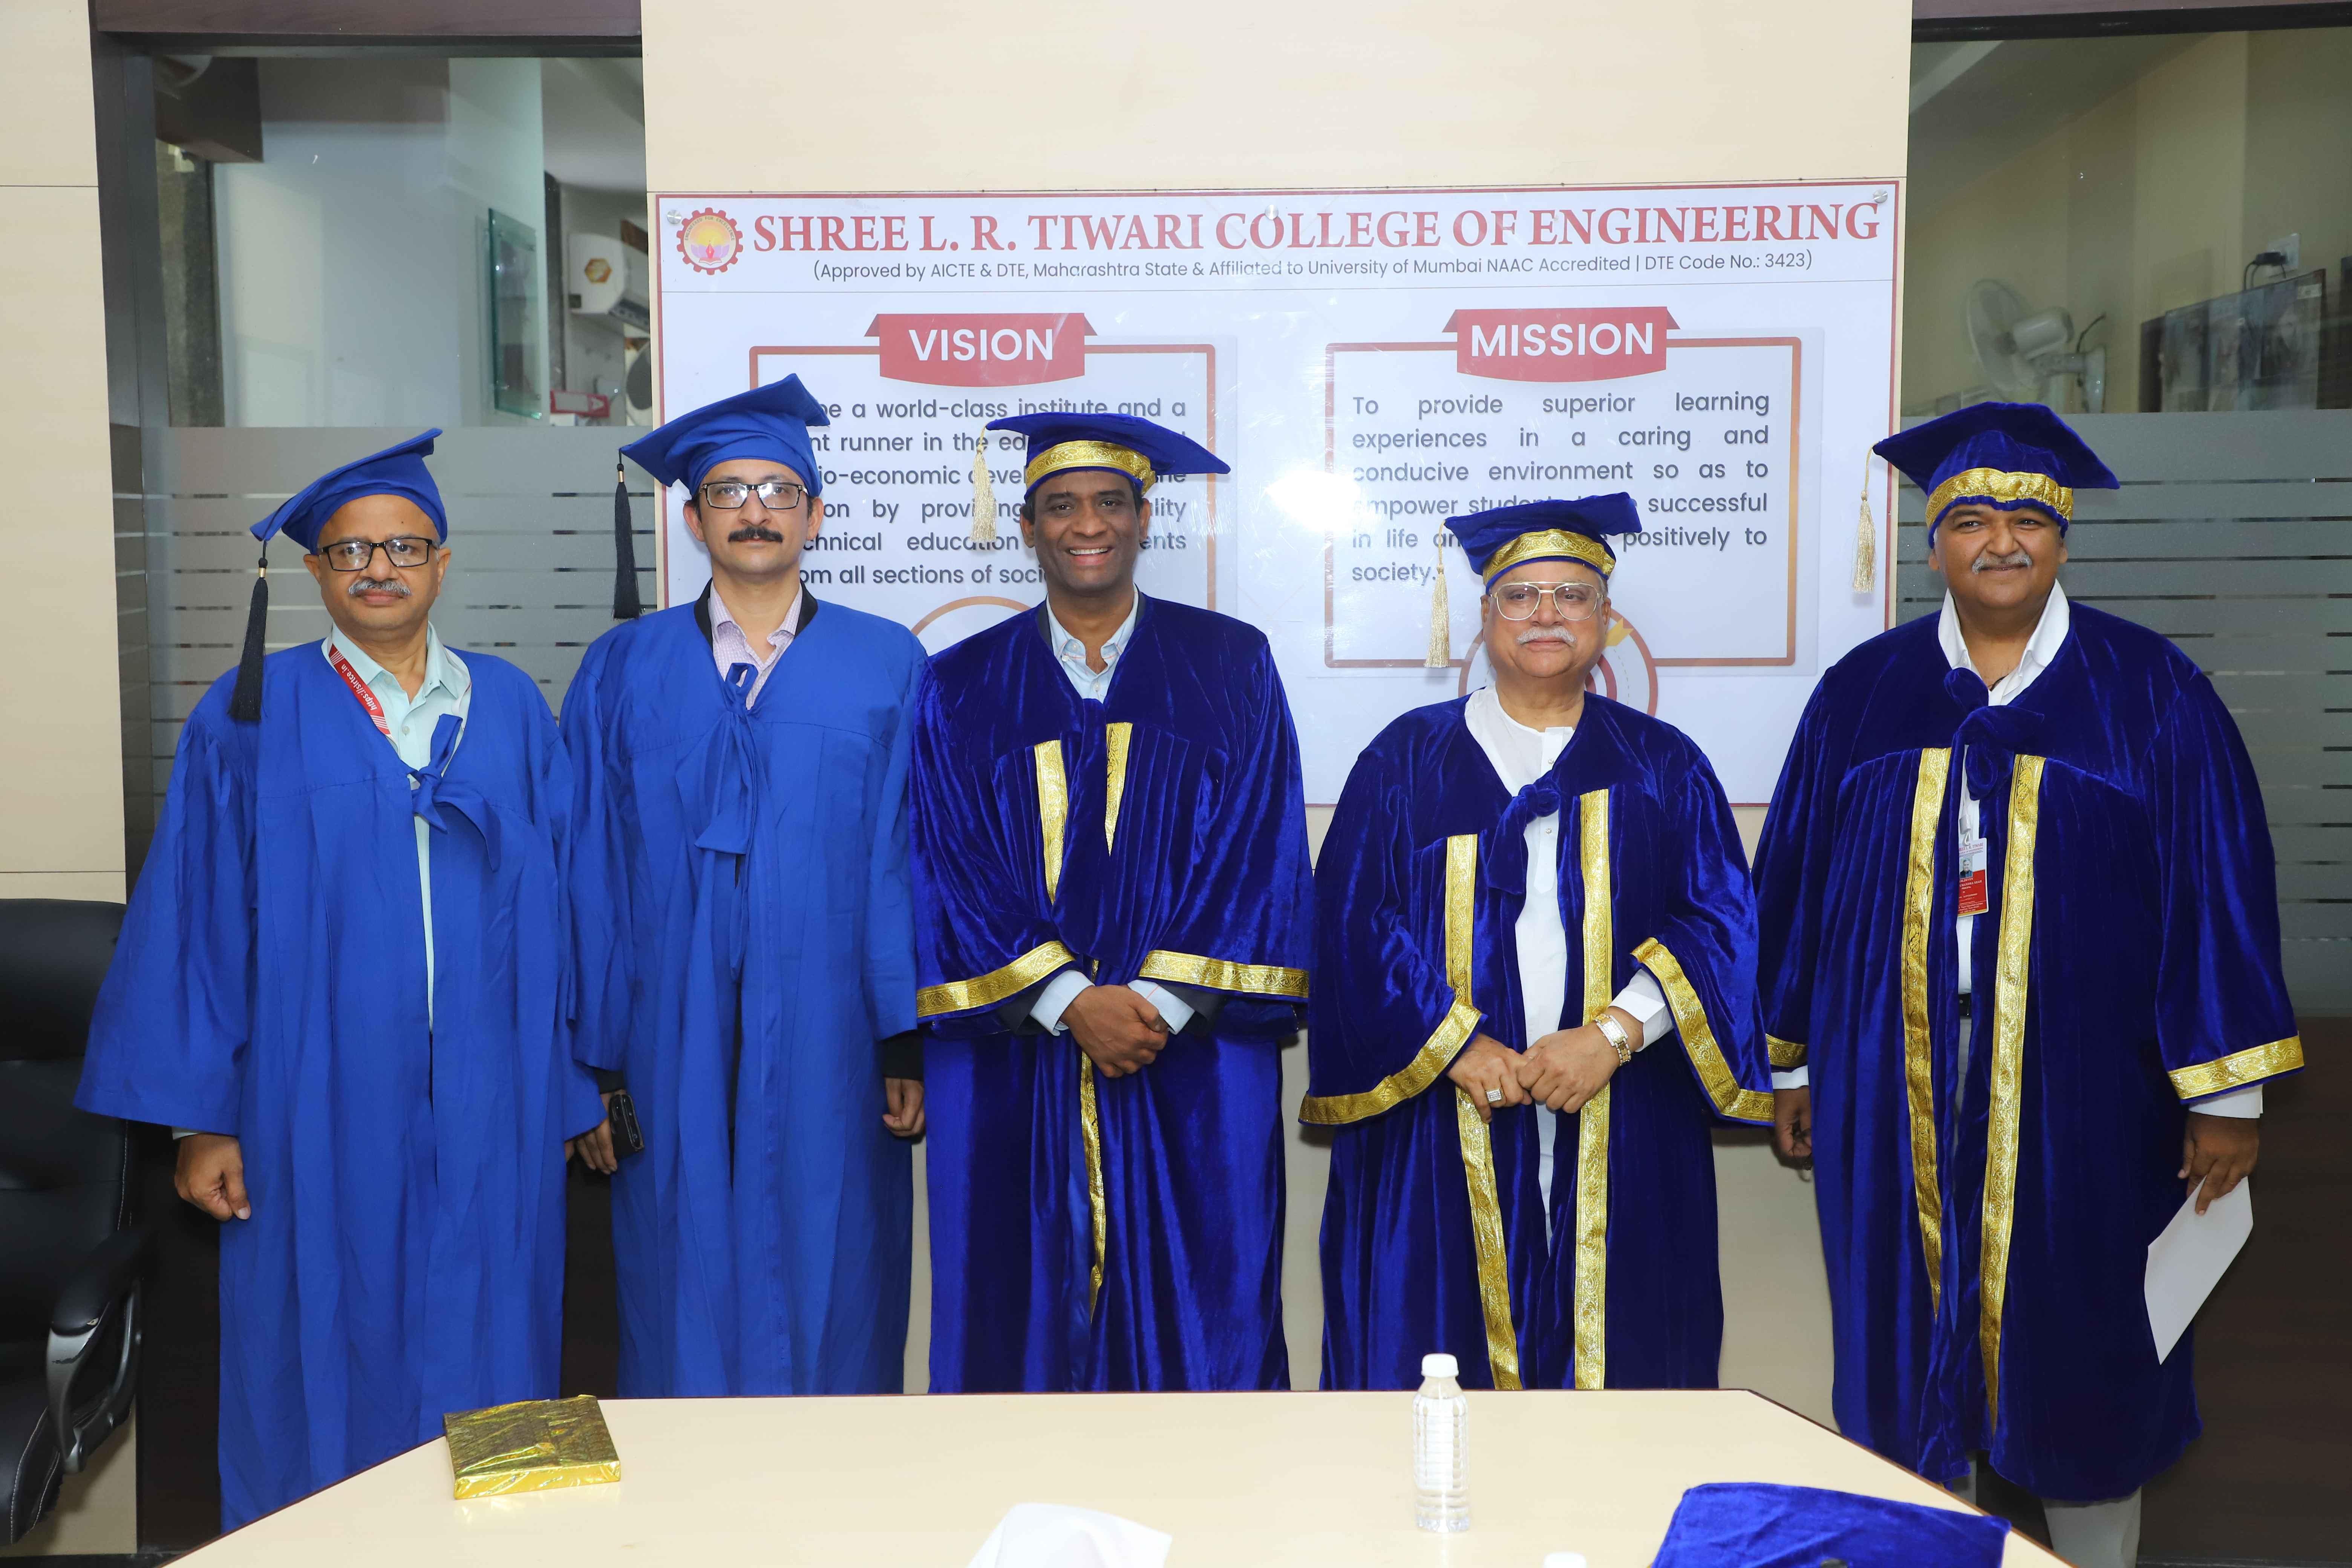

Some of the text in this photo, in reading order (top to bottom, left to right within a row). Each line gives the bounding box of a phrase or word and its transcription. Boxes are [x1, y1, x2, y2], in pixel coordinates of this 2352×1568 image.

[684, 218, 703, 241] ENGINEERED
[716, 219, 735, 241] EXCELLENCE
[754, 202, 1880, 252] SHREE L. R. TIWARI COLLEGE OF ENGINEERING
[814, 260, 900, 282] (Approved
[906, 263, 926, 282] by
[931, 263, 975, 277] AICTE
[980, 263, 992, 277] &
[997, 263, 1029, 279] DTE,
[1034, 262, 1139, 277] Maharashtra
[1145, 262, 1187, 276] State
[1192, 262, 1204, 276] &
[1209, 261, 1282, 276] Affiliated
[1287, 261, 1303, 275] to
[1309, 260, 1388, 278] University
[1393, 259, 1409, 274] of
[1414, 258, 1481, 273] Mumbai
[1487, 258, 1533, 273] NAAC
[1539, 256, 1630, 271] Accredited
[1645, 256, 1674, 270] DTE
[1679, 255, 1725, 269] Code
[1730, 254, 1759, 268] No.:
[1765, 249, 1812, 270] 3423)
[908, 329, 1052, 361] VISION
[1472, 323, 1653, 357] MISSION
[852, 404, 866, 418] a
[876, 398, 1008, 418] world-class
[1018, 398, 1107, 415] institute
[1118, 398, 1161, 416] and
[1171, 402, 1185, 416] a
[1353, 390, 1769, 420] To provide superior learning
[841, 436, 913, 452] runner
[923, 432, 942, 451] in
[953, 432, 989, 451] the
[1352, 424, 1769, 454] experiences in a caring and
[818, 465, 960, 485] io-economic
[1353, 460, 1769, 482] conducive environment so as to
[873, 499, 899, 524] by
[922, 498, 1026, 524] proving
[1648, 492, 1767, 513] successful
[1353, 527, 1767, 552] in life an positively to
[839, 565, 864, 584] all
[873, 564, 964, 584] sections
[971, 564, 992, 583] of
[1352, 562, 1436, 586] society.
[341, 664, 377, 711] https://slrtce.in
